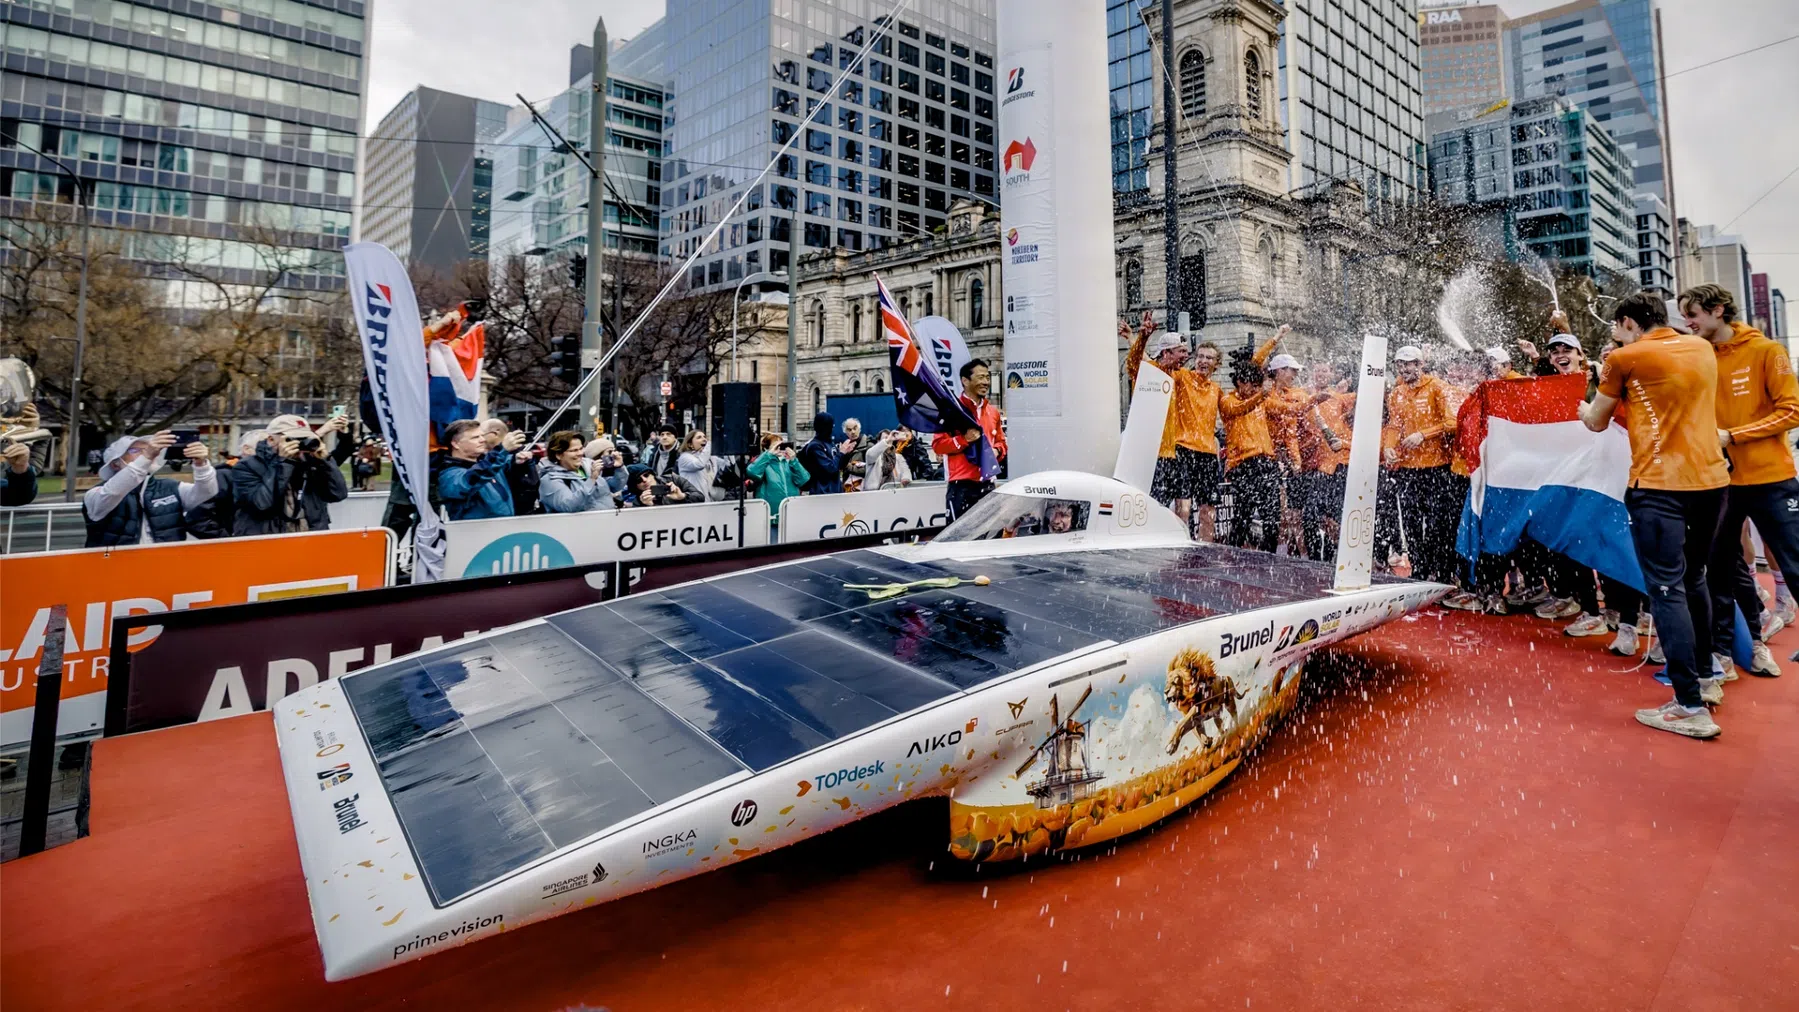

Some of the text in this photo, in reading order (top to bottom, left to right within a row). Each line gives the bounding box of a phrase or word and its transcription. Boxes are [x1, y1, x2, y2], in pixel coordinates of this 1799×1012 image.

[1428, 10, 1462, 24] RAA
[1006, 173, 1030, 186] SOUTH
[1011, 244, 1038, 256] NORTHERN
[1011, 253, 1038, 265] TERRITORY
[1007, 360, 1048, 370] BRIDGESTONE
[1367, 364, 1385, 378] Brunel
[1024, 370, 1049, 378] WORLD
[1025, 486, 1057, 496] Brunel
[1118, 493, 1148, 528] 03
[1347, 507, 1373, 548] 03
[617, 524, 733, 552] OFFICIAL
[1321, 610, 1342, 624] WORLD
[1220, 620, 1275, 660] Brunel
[996, 720, 1034, 736] CUPRA
[906, 730, 962, 758] AIKO
[814, 760, 885, 791] TOPdesk
[333, 793, 368, 835] Brunel
[732, 800, 757, 827] hp
[642, 829, 697, 854] INGKA
[645, 841, 694, 859] INVESTMENTS
[542, 873, 589, 892] SINGAPORE
[552, 879, 588, 894] AIRLINES
